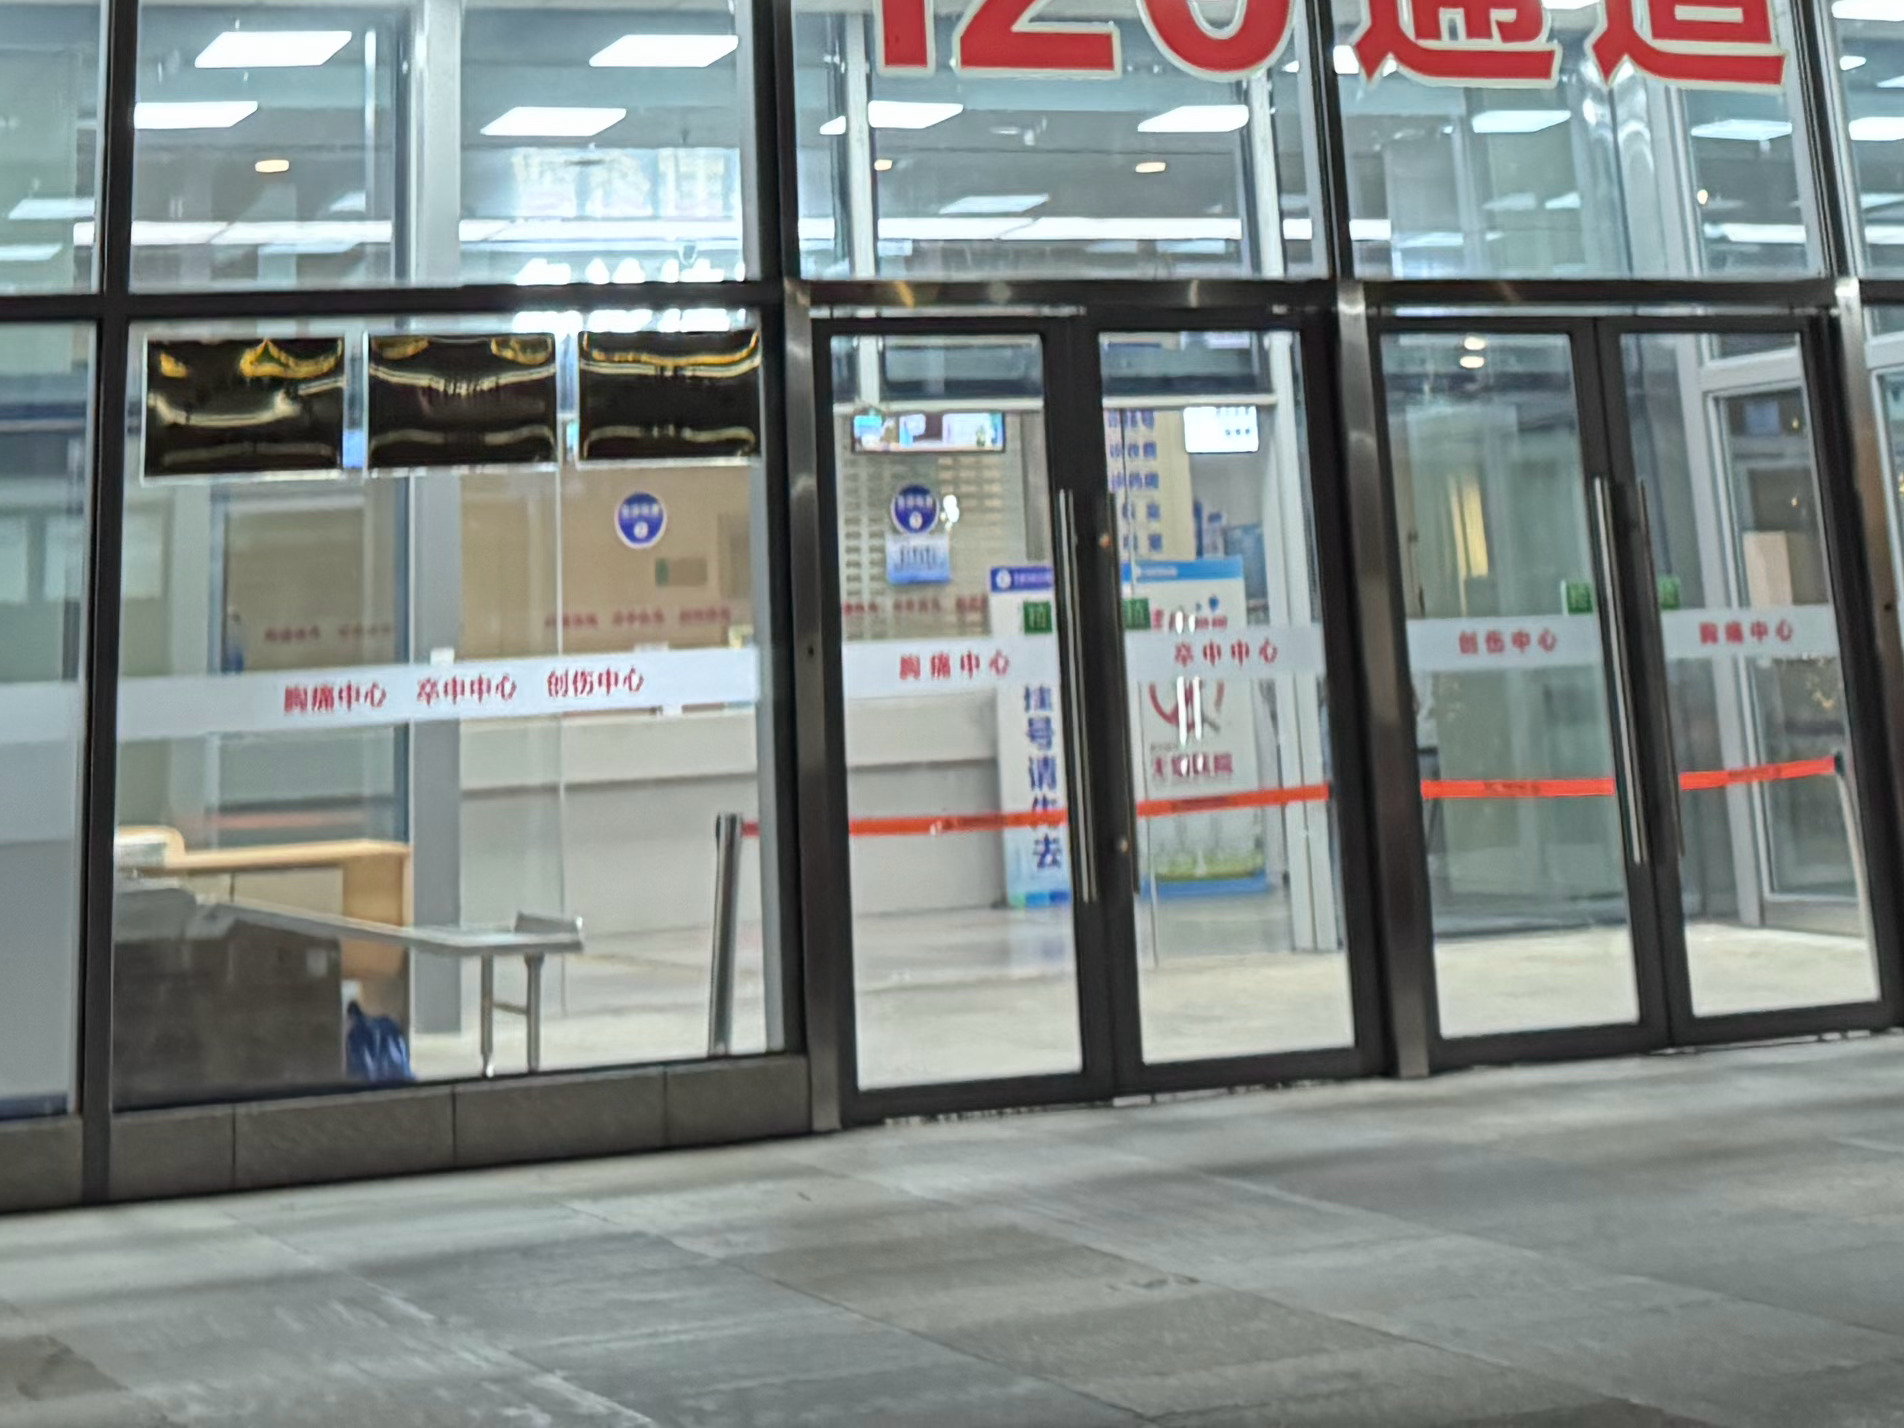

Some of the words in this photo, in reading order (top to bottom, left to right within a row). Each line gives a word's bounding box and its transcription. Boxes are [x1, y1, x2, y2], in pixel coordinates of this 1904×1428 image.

[1173, 637, 1279, 668] 卒中中心
[1458, 626, 1558, 657] 创伤中心
[899, 649, 1010, 681] 胸痛中心
[283, 680, 387, 715] 胸痛中心
[416, 672, 517, 707] 卒中中心
[546, 665, 645, 699] 创伤中心
